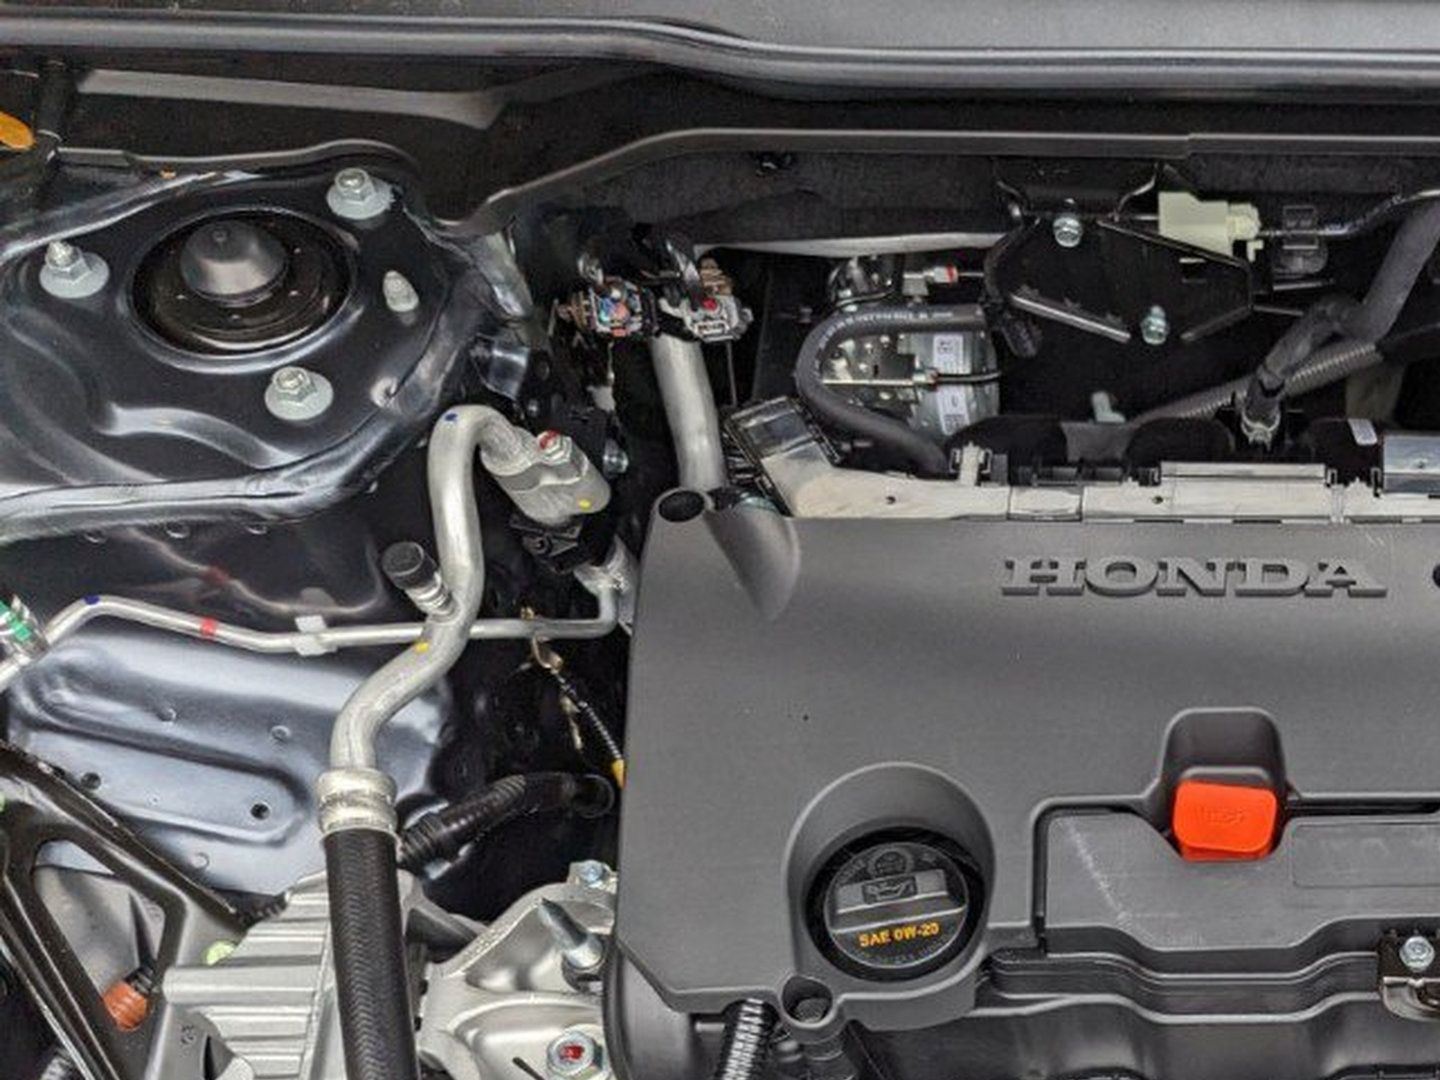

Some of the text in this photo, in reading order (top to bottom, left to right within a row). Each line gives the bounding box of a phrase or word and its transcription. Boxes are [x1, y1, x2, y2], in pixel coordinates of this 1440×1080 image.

[1001, 556, 1388, 598] HONDA
[858, 922, 940, 947] SAE 0W-20
